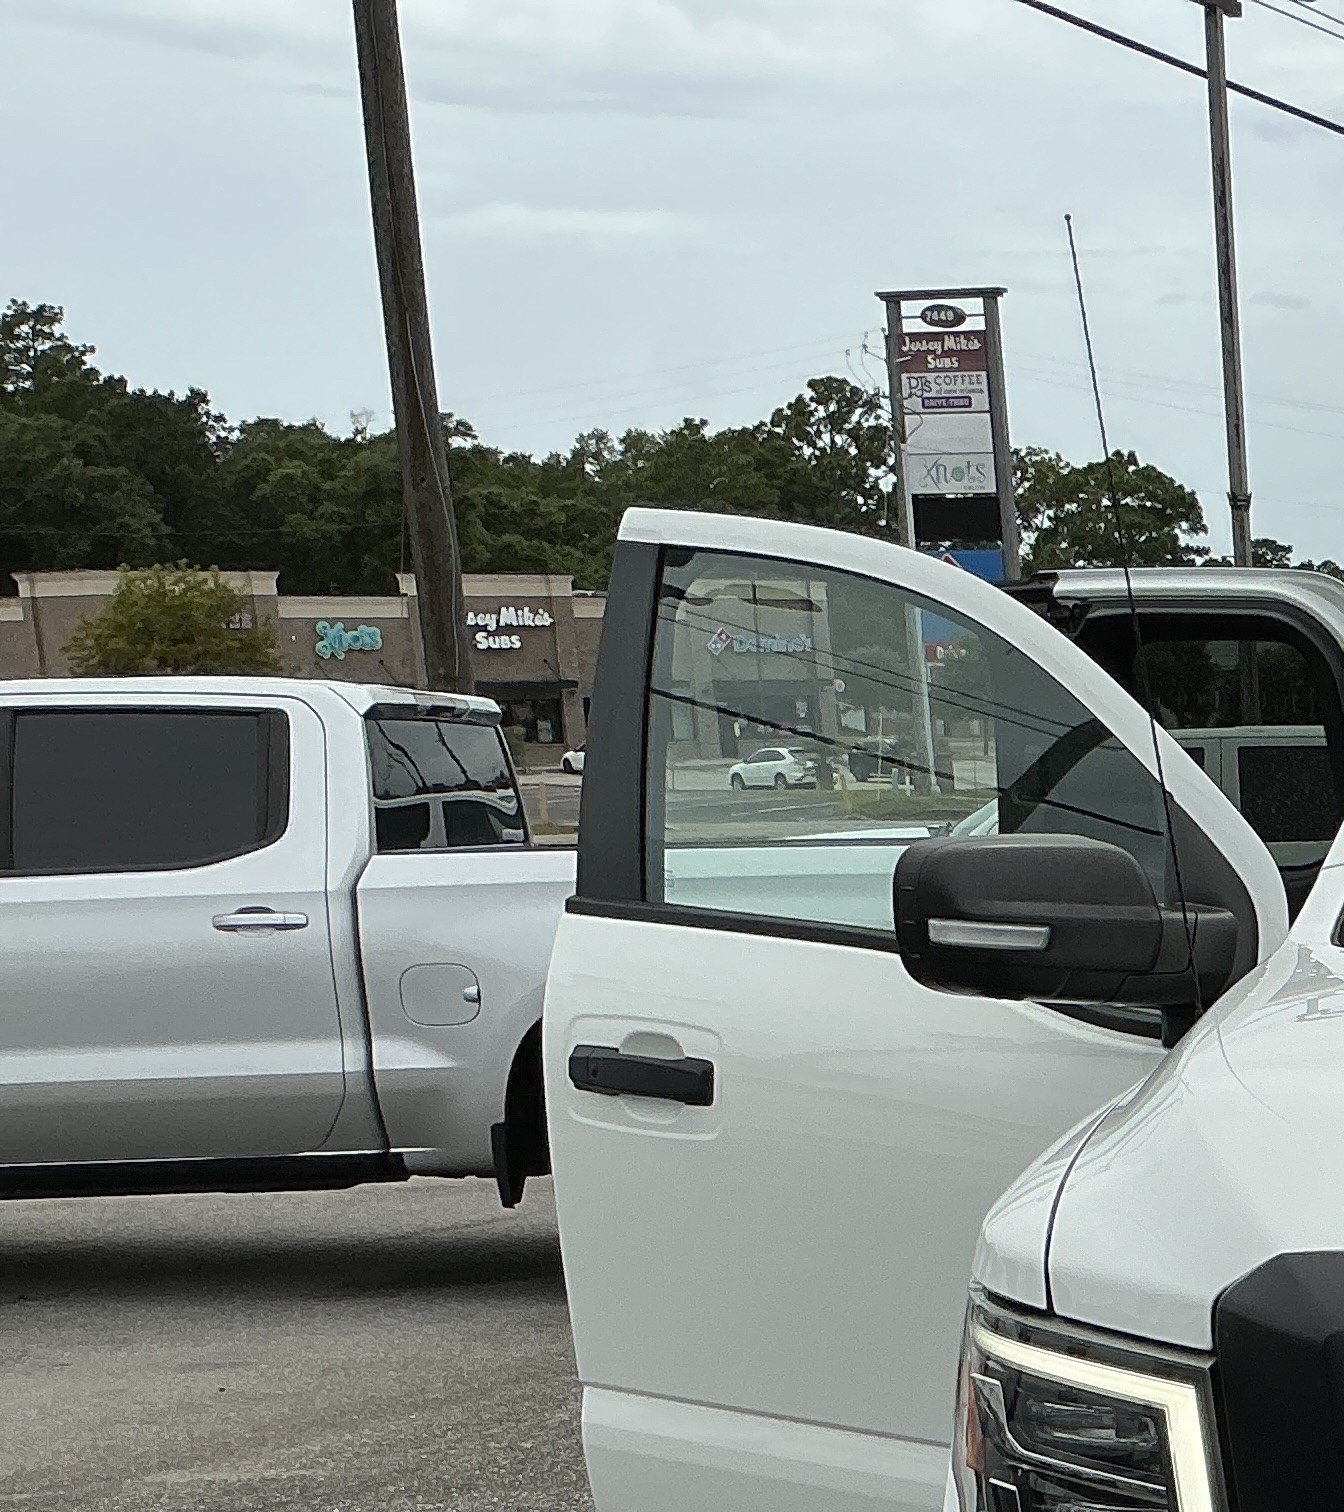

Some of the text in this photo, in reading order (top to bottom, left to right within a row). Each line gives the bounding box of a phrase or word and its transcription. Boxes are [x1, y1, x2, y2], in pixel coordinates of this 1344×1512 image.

[901, 334, 982, 355] Jersey Mike's
[934, 374, 983, 386] COFFEE
[499, 606, 555, 627] Mike's
